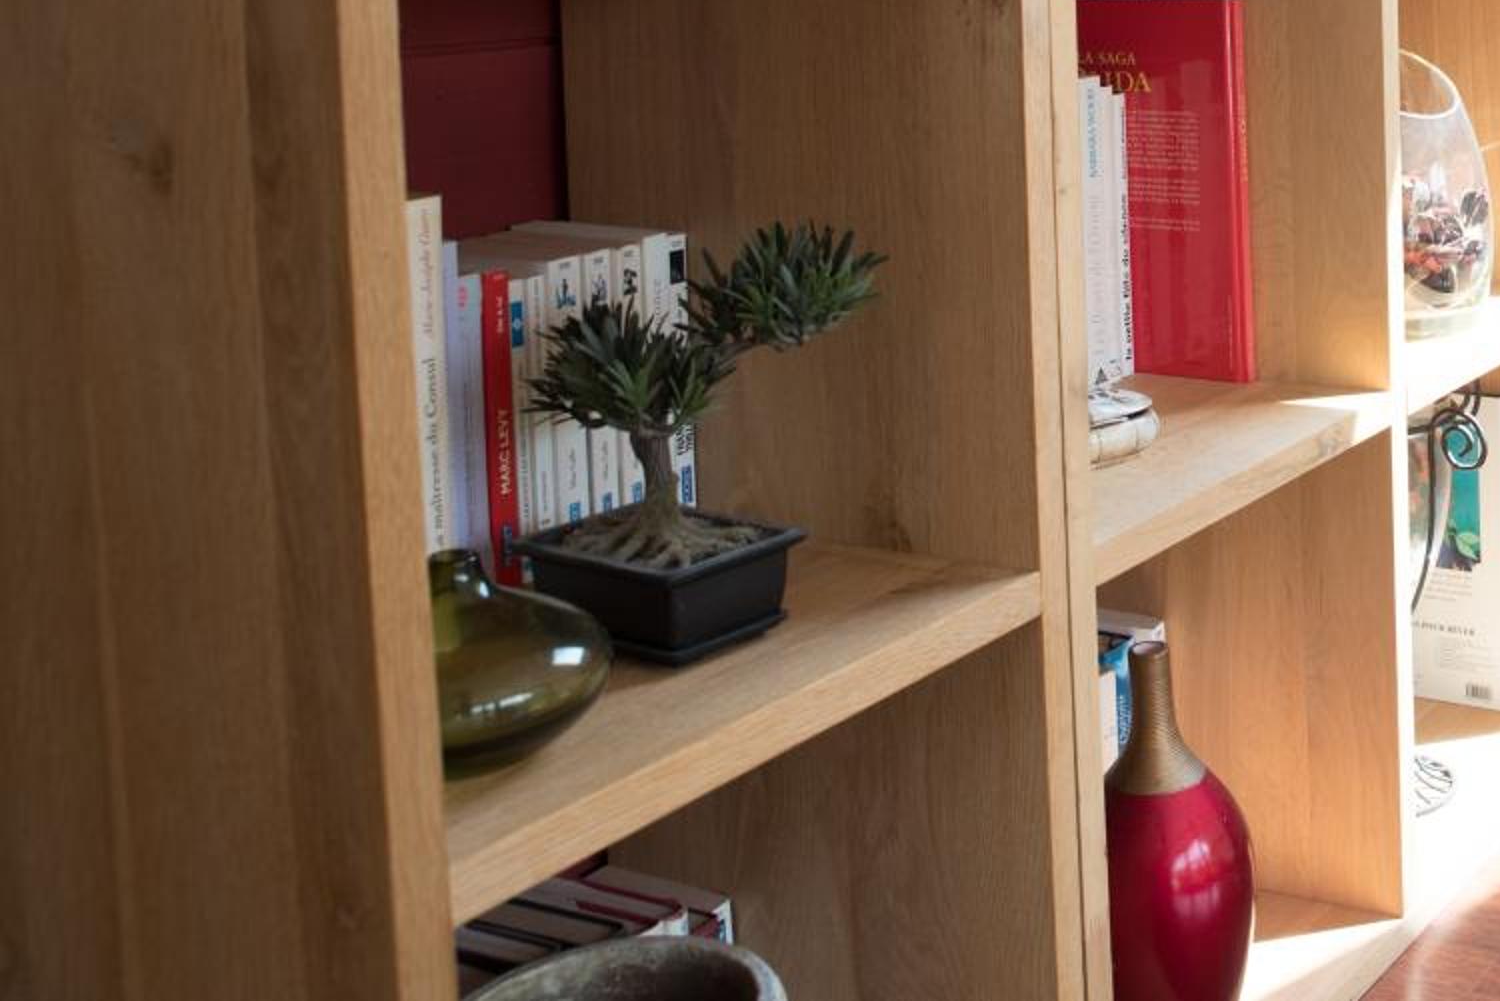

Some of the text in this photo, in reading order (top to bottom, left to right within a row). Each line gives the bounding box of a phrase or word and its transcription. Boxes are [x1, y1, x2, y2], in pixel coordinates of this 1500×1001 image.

[1099, 51, 1136, 66] SAGA
[421, 357, 440, 419] Consul
[497, 408, 511, 495] MARC LEVY
